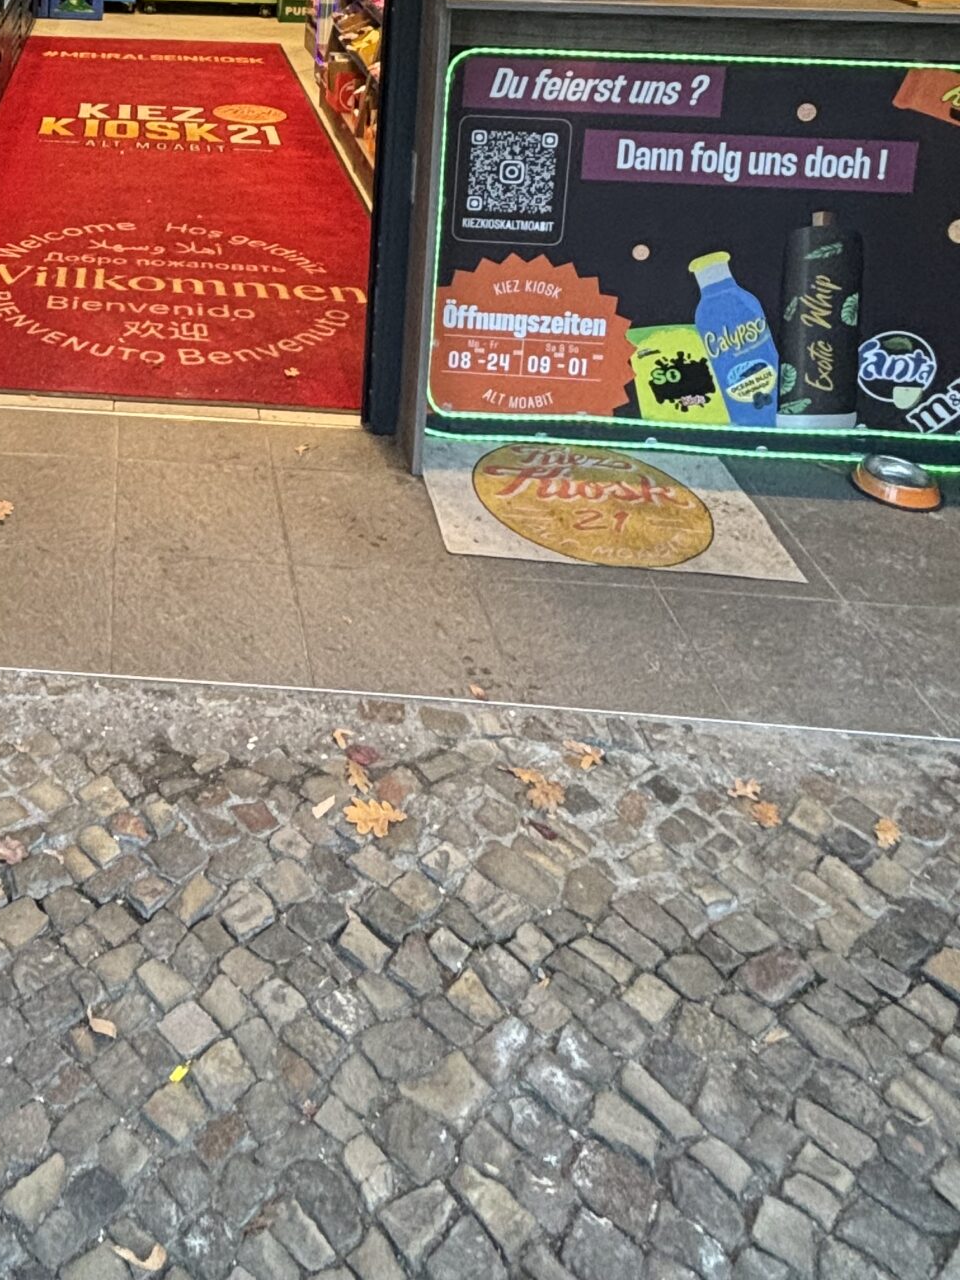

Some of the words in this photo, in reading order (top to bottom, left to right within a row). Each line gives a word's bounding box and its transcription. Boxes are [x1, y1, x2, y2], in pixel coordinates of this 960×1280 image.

[489, 67, 530, 100] Du
[531, 68, 628, 104] feierst
[628, 79, 683, 106] uns
[689, 74, 712, 107] ?
[77, 102, 206, 123] KIEZ
[38, 116, 224, 144] KIOSK
[226, 124, 283, 147] 21
[85, 138, 121, 149] ALT
[135, 141, 226, 154] MOABIT
[615, 138, 685, 172] Dann
[689, 141, 742, 183] folg
[748, 150, 799, 177] uns
[804, 145, 872, 181] doch
[876, 148, 889, 181] !
[42, 251, 128, 267] Добро
[227, 234, 329, 275] geldiniz
[493, 279, 521, 297] KIEZ
[524, 279, 563, 300] KIOSK
[799, 274, 843, 330] Whip
[45, 294, 256, 321] Bienvenido
[442, 298, 608, 339] Öffnungszeiten
[122, 319, 212, 342] 欢迎
[177, 308, 351, 366] Benvenuto
[703, 316, 767, 359] Calypso
[447, 350, 471, 370] 08
[527, 354, 551, 374] 09
[804, 339, 835, 392] Exotic
[651, 367, 682, 386] SO
[481, 388, 507, 406] ALT
[507, 390, 555, 410] MOABIT
[571, 508, 632, 534] 21
